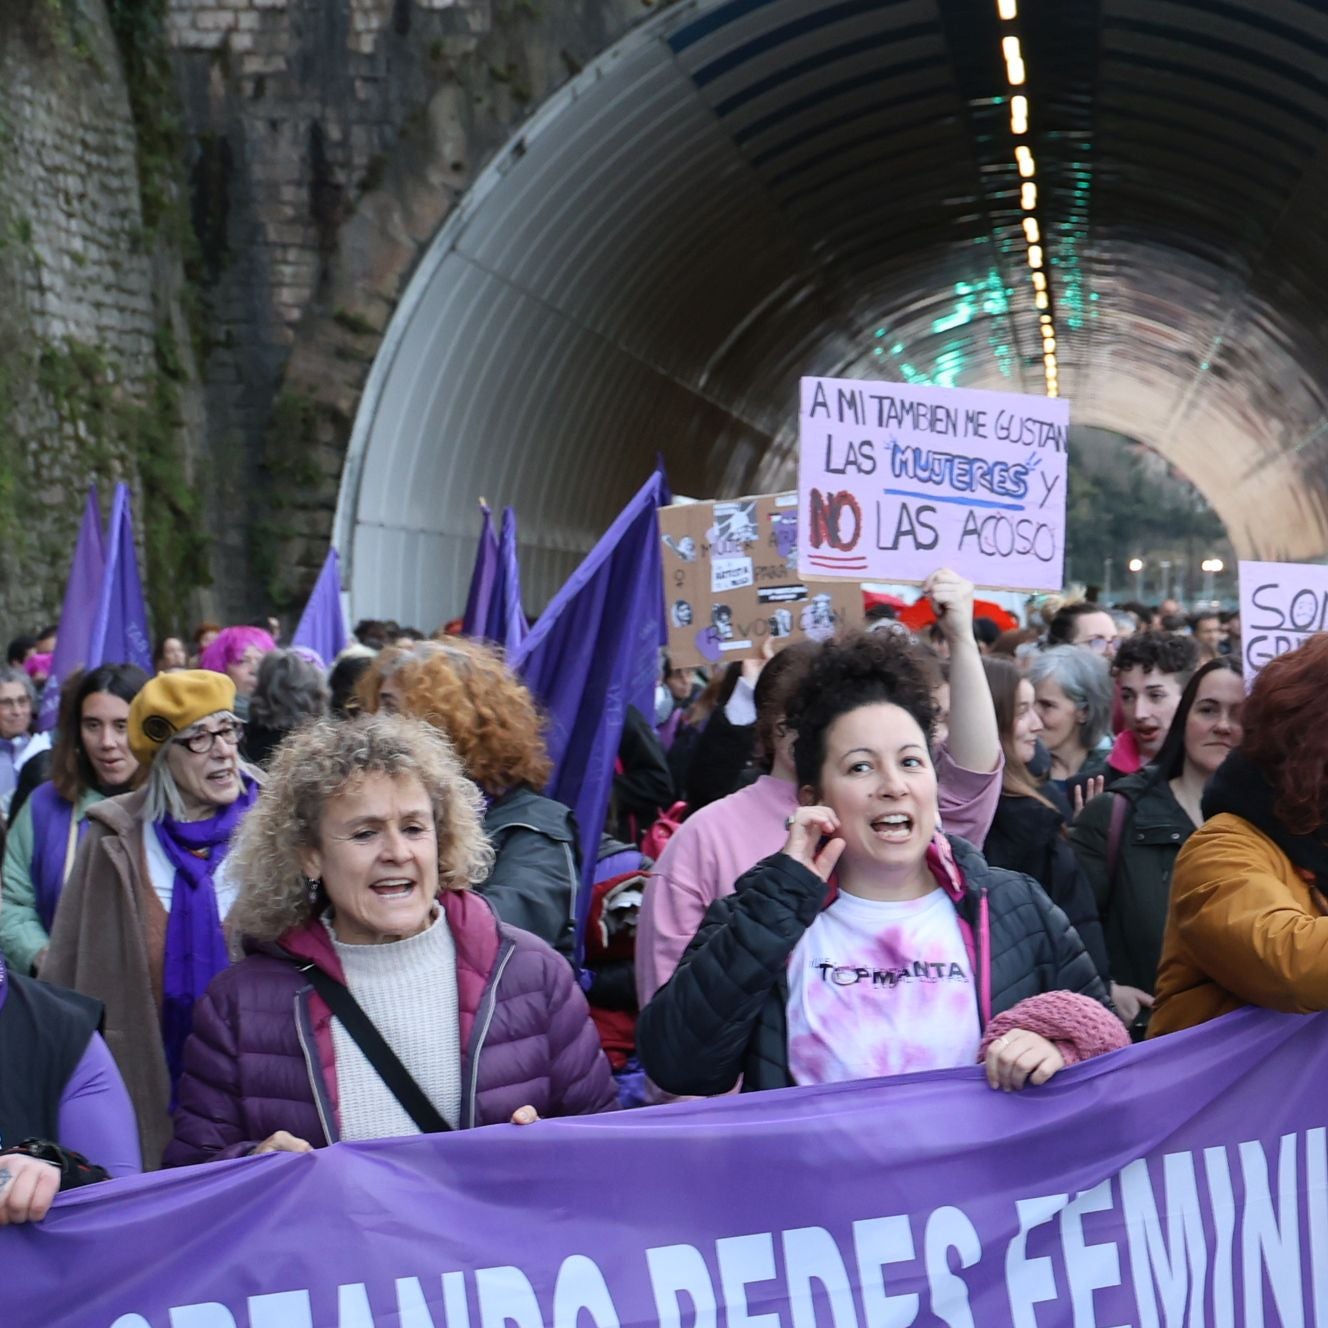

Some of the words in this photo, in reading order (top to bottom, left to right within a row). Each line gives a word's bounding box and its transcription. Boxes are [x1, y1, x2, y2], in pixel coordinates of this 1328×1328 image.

[809, 381, 832, 419] A
[837, 388, 867, 426] MI
[869, 394, 958, 437] TAMBIEN
[964, 408, 989, 439] ME
[825, 433, 877, 475] LAS
[891, 443, 1030, 500] MUJERES
[1038, 470, 1060, 509] Y
[808, 487, 862, 552] NO
[875, 500, 940, 551] LAS
[958, 509, 1056, 562] ACOSO
